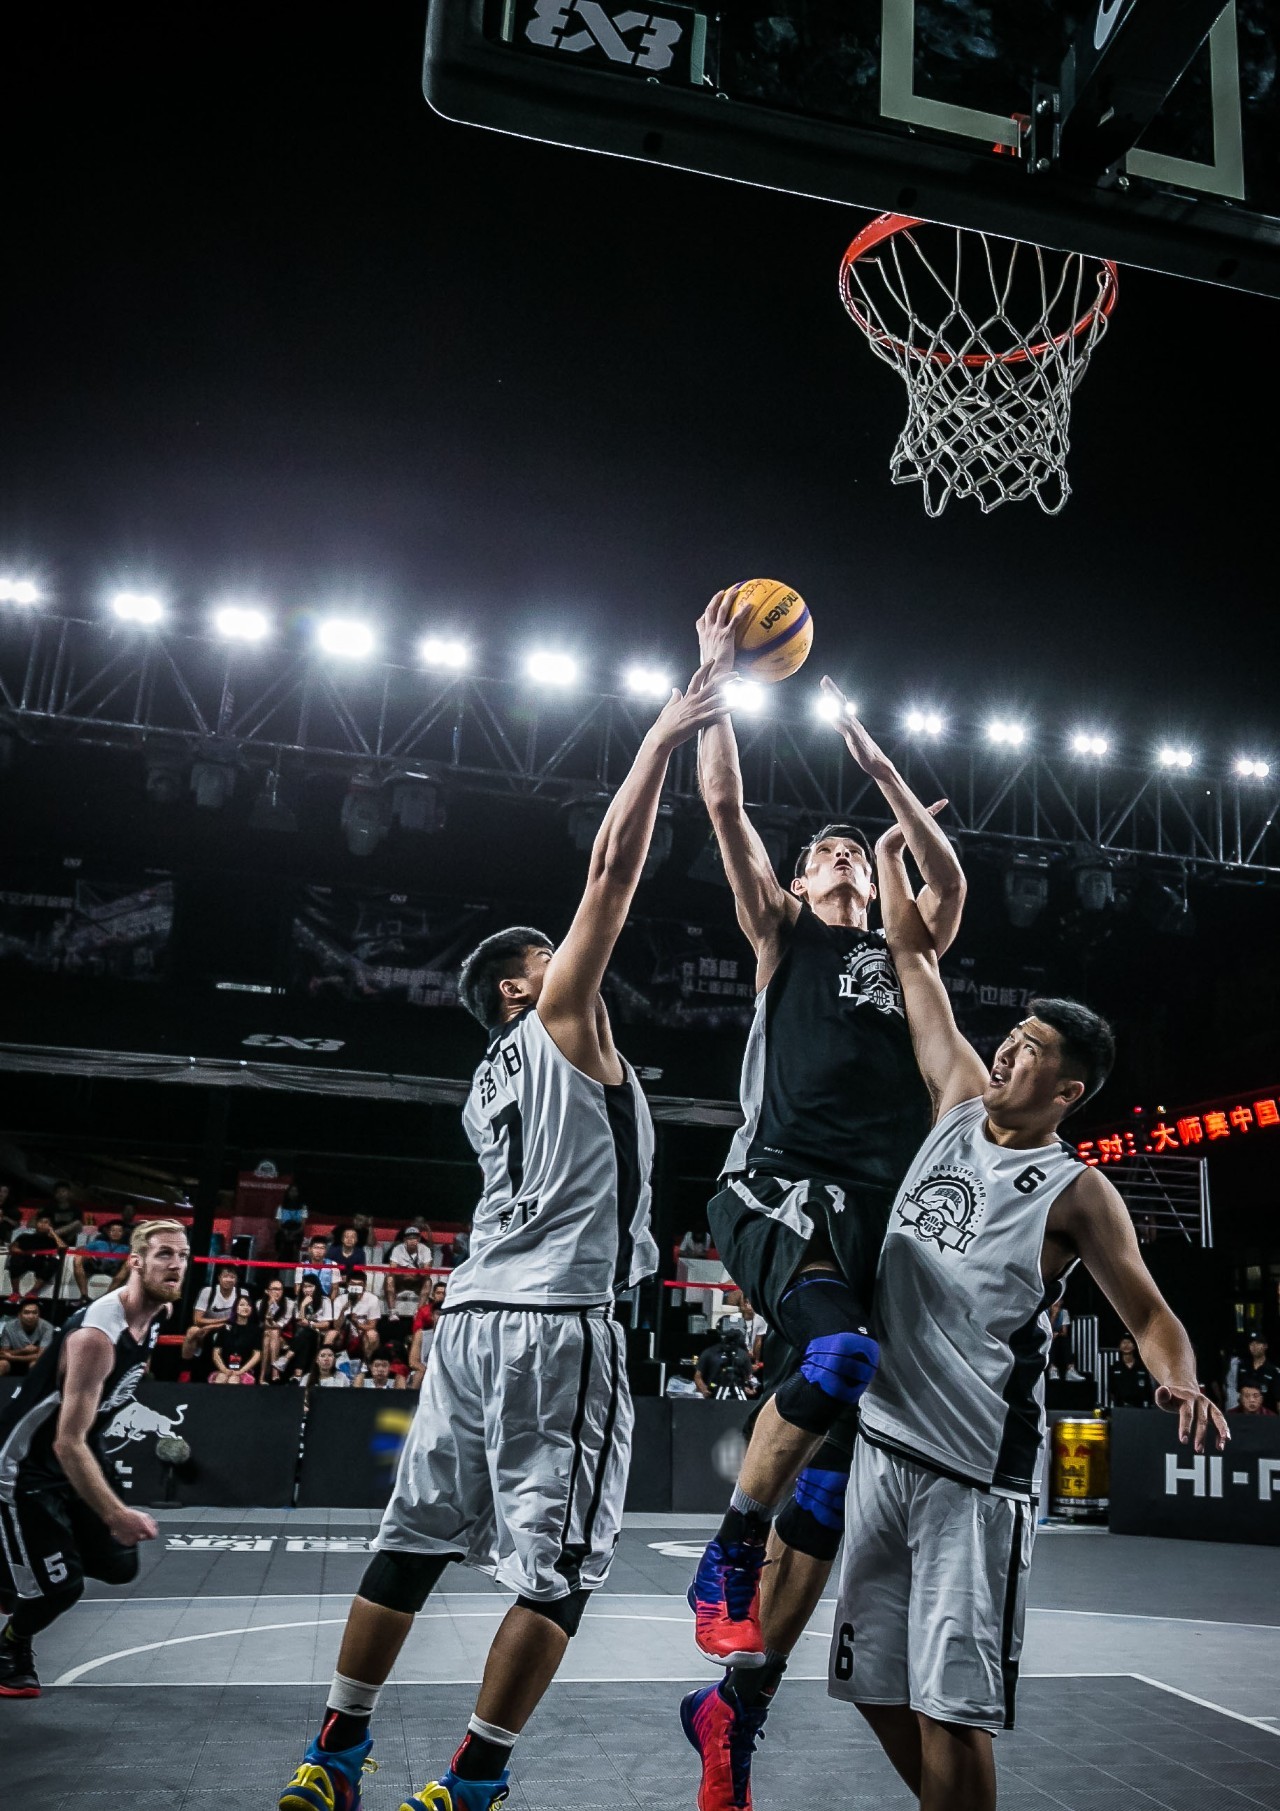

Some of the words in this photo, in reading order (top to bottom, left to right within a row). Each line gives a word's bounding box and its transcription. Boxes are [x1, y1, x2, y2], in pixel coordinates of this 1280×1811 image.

[490, 1099, 524, 1200] 7
[933, 1165, 974, 1177] RAISING
[1013, 1165, 1047, 1194] 6
[43, 1551, 68, 1584] 5
[835, 1622, 855, 1681] 6
